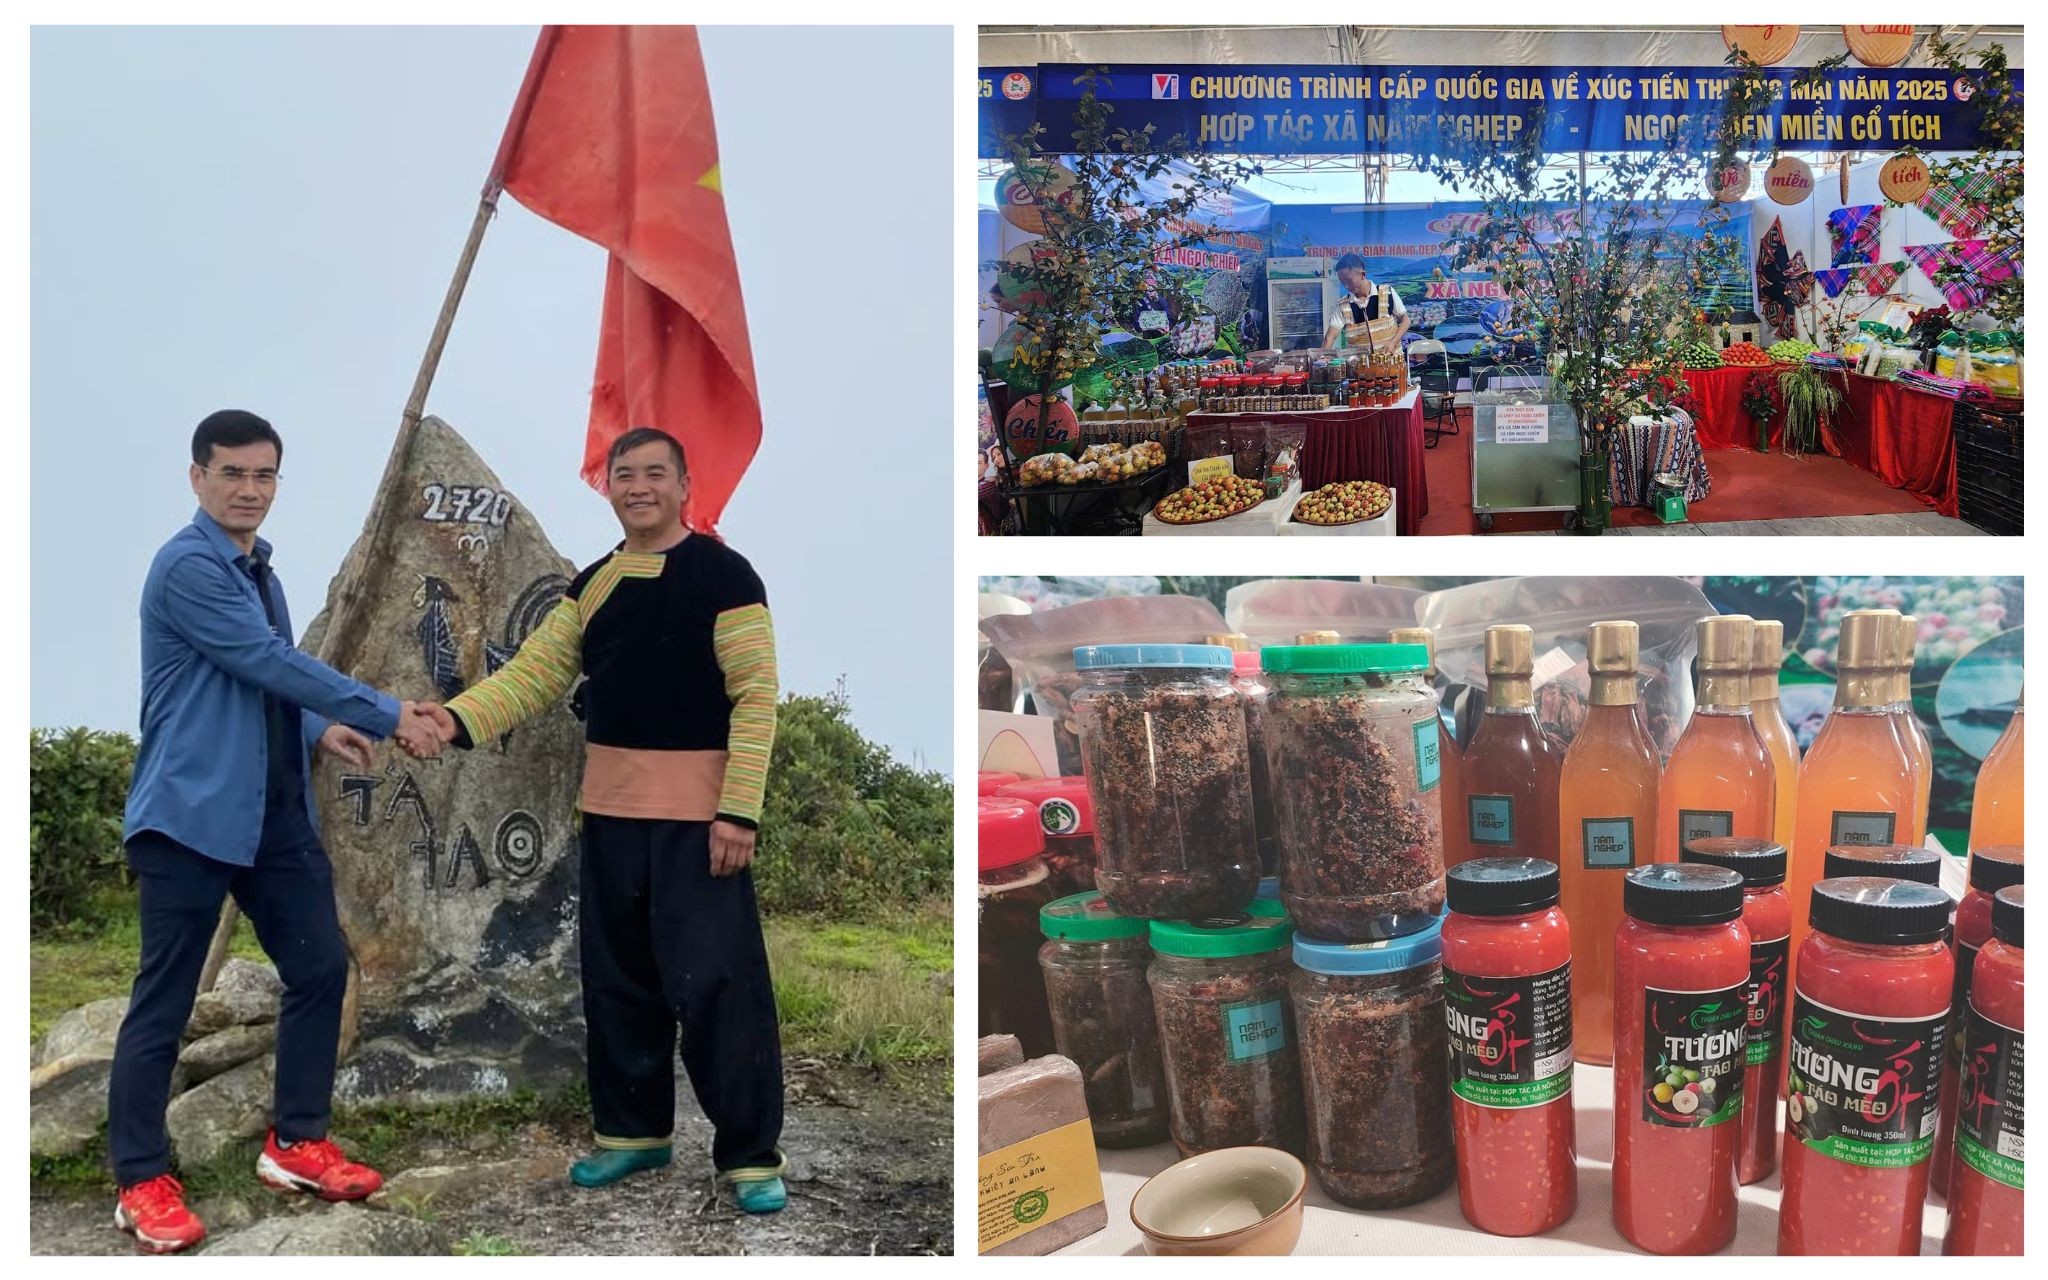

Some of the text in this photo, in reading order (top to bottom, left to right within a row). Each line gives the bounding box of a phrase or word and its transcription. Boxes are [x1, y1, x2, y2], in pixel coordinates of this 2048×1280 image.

[1190, 74, 1291, 99] CHƯƠNG
[1300, 73, 1371, 99] TRÌNH
[1379, 70, 1427, 99] CẤP
[1435, 71, 1497, 101] QUỐC
[1505, 78, 1545, 99] GIA
[1552, 72, 1579, 99] VỀ
[1586, 73, 1632, 100] XÚC
[1639, 72, 1689, 99] TIẾN
[1839, 75, 1889, 100] NĂM
[1896, 79, 1947, 100] 2025
[1201, 111, 1254, 147] HỢP
[1264, 108, 1313, 141] TÁC
[1323, 109, 1358, 141] XÃ
[1781, 106, 1843, 141] MIỀN
[1851, 105, 1882, 140] CỔ
[1889, 110, 1941, 140] TÍCH
[1893, 166, 1923, 184] tích
[1008, 418, 1069, 441] Chến
[423, 485, 511, 526] 2720
[1665, 1023, 1747, 1062] TƯƠNG
[1701, 1061, 1730, 1079] TÁO
[1792, 1034, 1880, 1095] TƯƠNG
[1806, 1080, 1838, 1106] TÁO
[1884, 1130, 1906, 1139] 350ml
